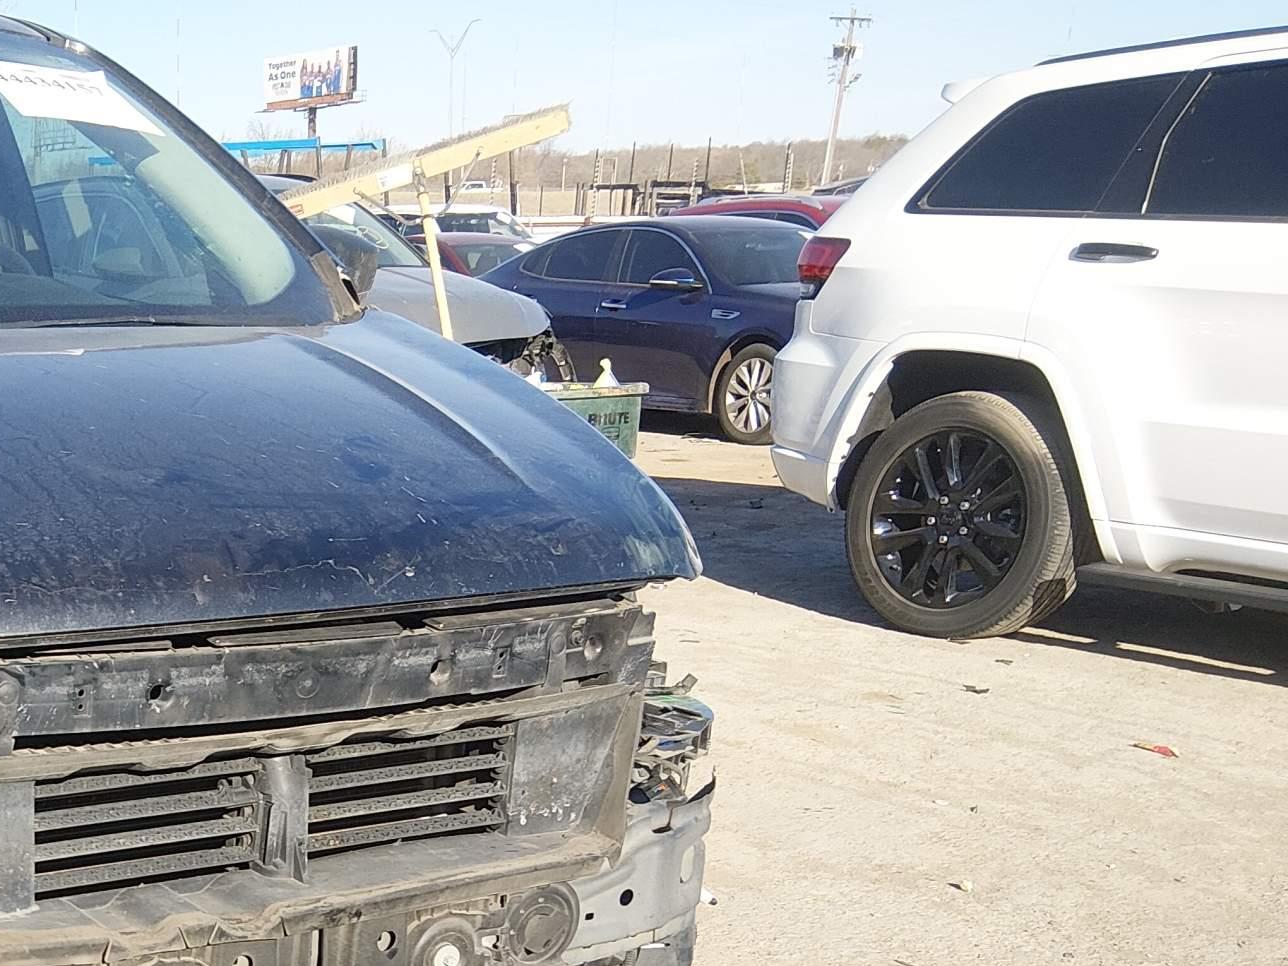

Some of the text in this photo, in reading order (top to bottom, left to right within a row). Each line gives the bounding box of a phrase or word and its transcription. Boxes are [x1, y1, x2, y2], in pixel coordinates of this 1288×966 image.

[268, 60, 297, 70] Together
[268, 71, 297, 81] As One
